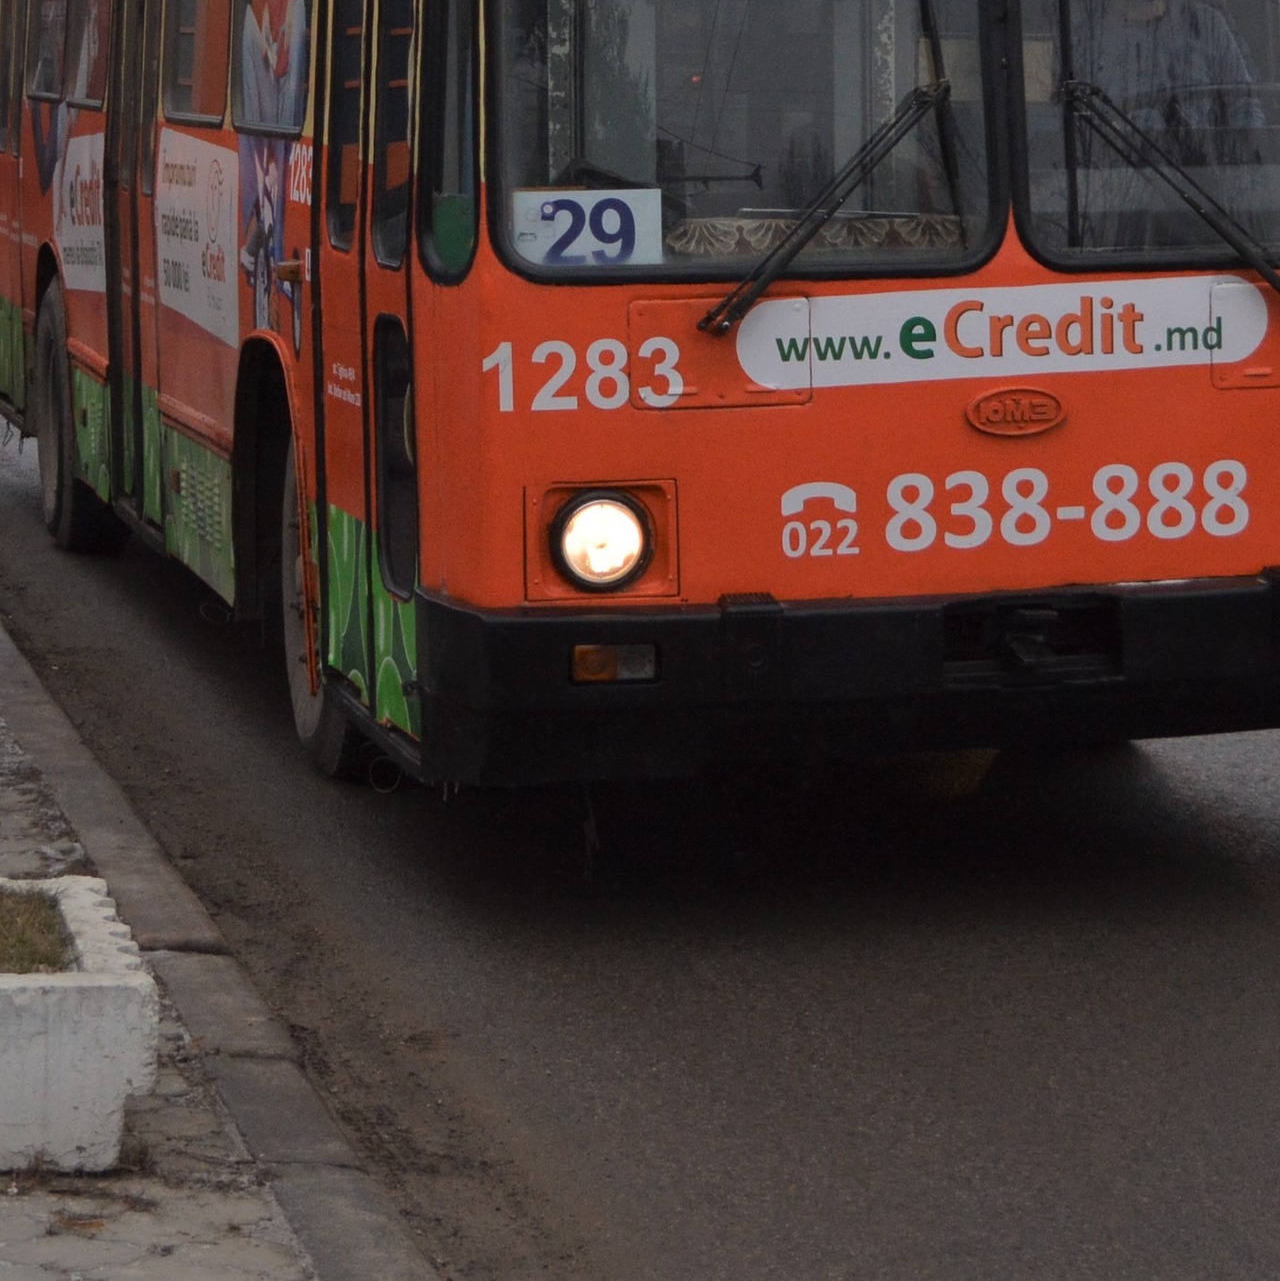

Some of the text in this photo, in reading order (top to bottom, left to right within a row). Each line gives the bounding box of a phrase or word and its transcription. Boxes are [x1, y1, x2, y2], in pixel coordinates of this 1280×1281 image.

[540, 197, 636, 265] 29
[481, 336, 684, 413] 1283
[780, 520, 860, 558] 022
[884, 459, 1250, 552] 838-888
